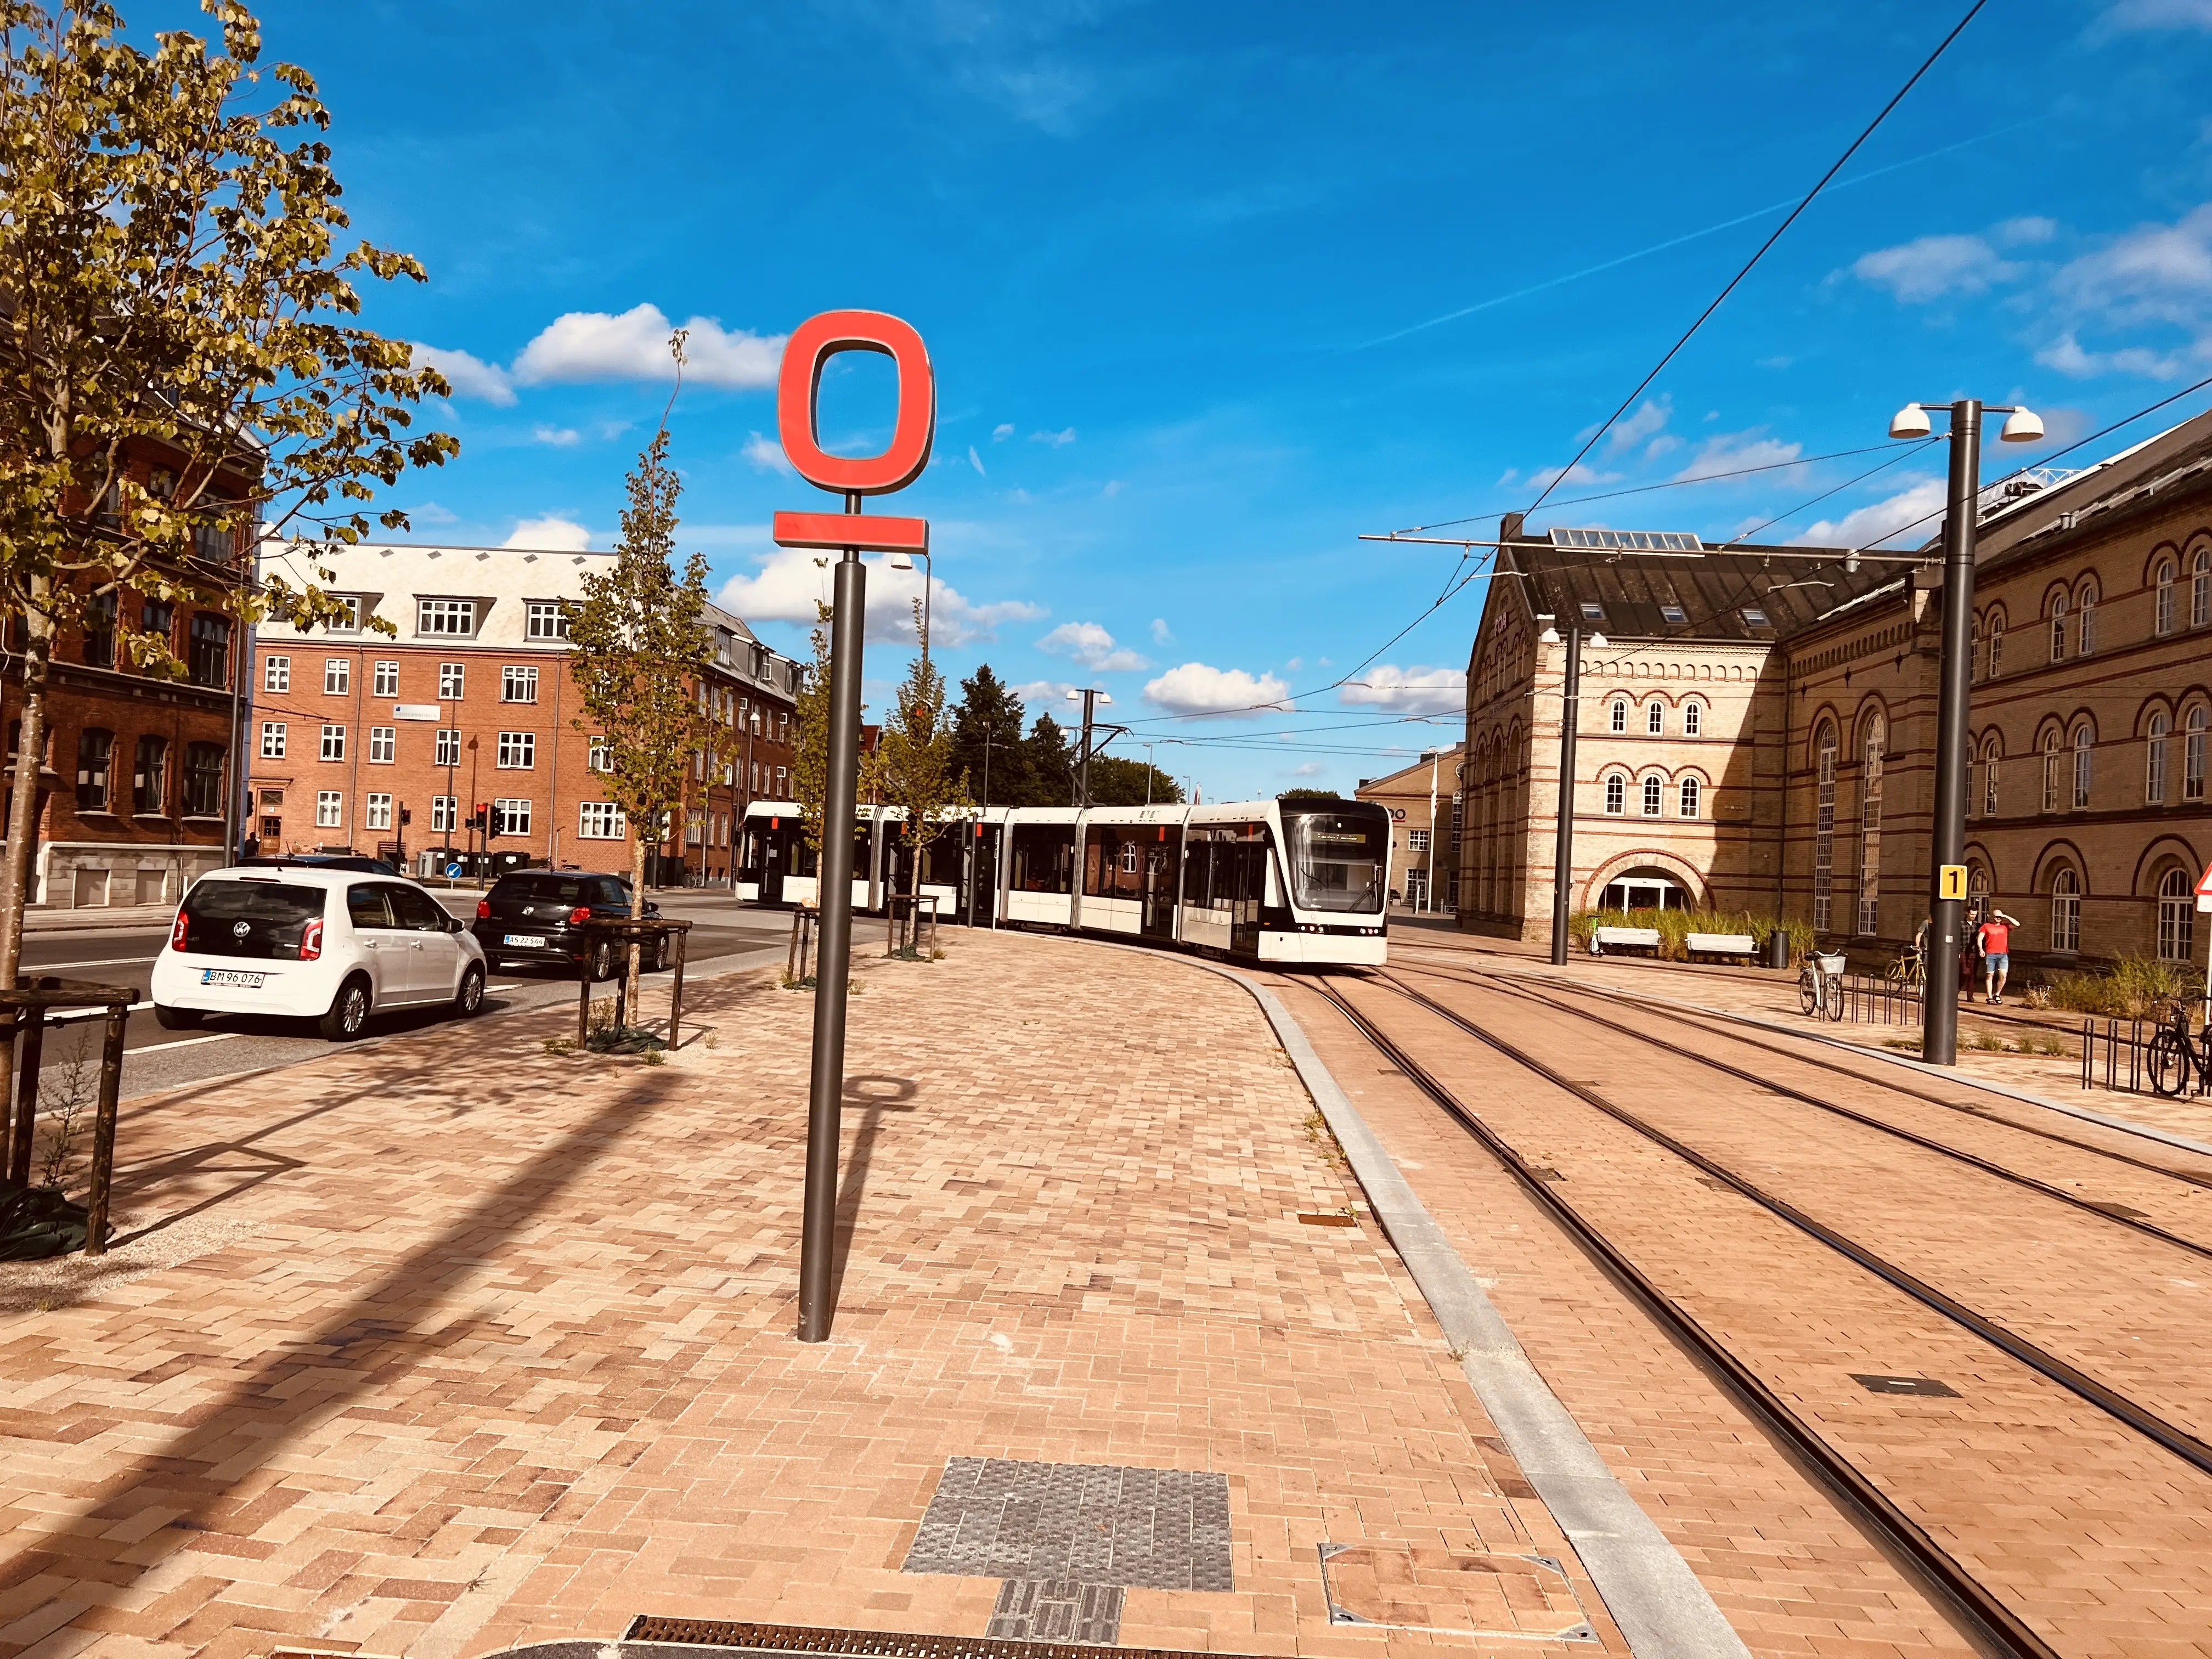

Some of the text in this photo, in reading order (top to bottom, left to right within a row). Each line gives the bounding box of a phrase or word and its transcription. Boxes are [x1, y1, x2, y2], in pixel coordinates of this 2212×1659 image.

[1949, 871, 1958, 894] 1
[210, 972, 259, 984] BM 96 076
